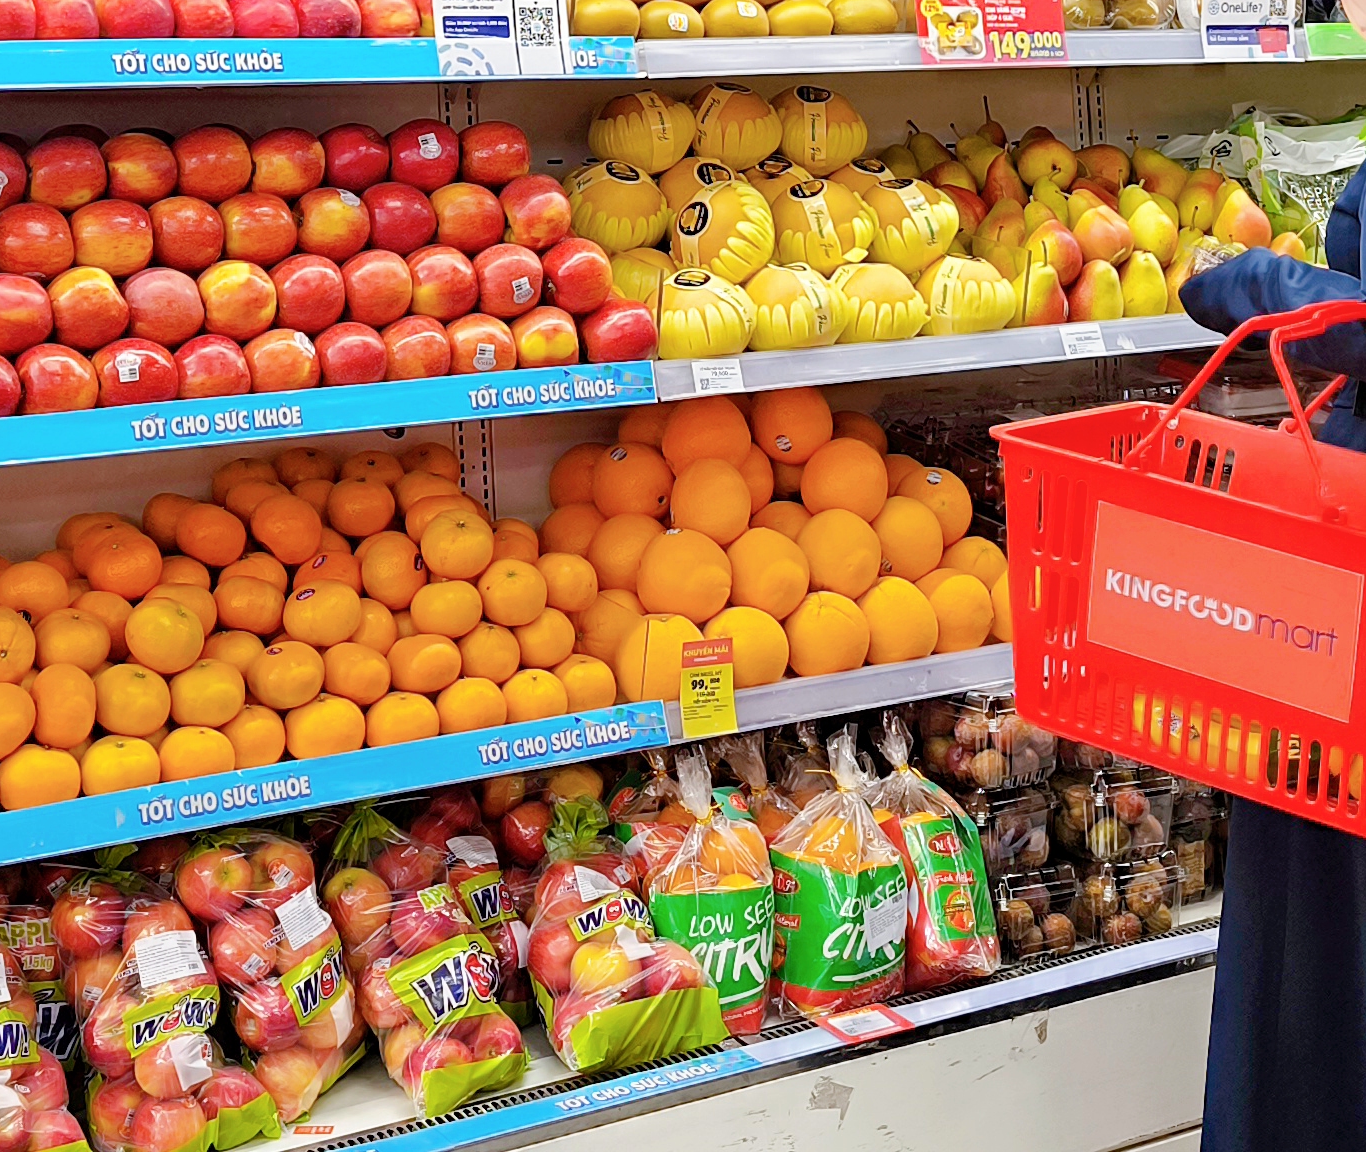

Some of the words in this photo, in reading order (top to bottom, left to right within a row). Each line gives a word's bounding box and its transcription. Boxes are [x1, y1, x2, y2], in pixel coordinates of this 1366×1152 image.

[112, 47, 150, 75] TỐT
[152, 52, 193, 73] CHO
[196, 48, 233, 73] SỨC
[235, 49, 283, 72] KHỎE
[1104, 568, 1338, 658] KINGFOODmart
[689, 913, 734, 938] LOW
[744, 894, 775, 930] SEE
[839, 895, 871, 918] LOW
[870, 874, 905, 910] SEE
[22, 955, 54, 972] 1.5kg
